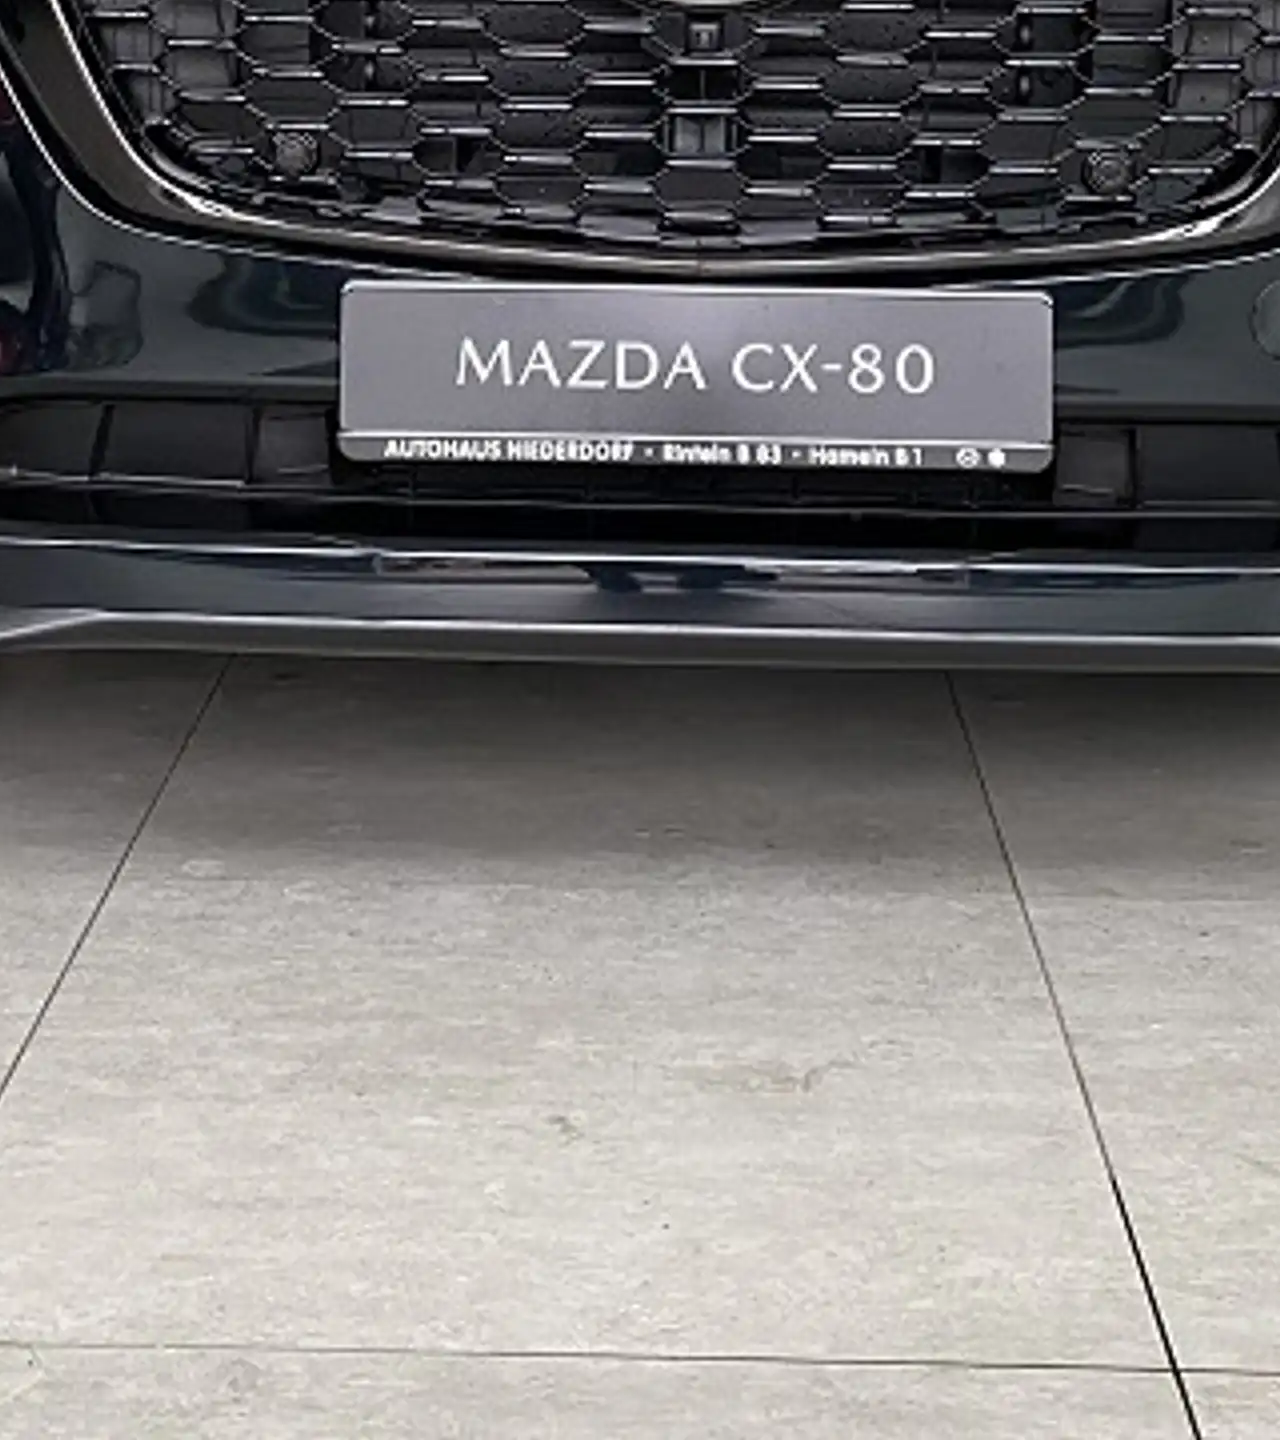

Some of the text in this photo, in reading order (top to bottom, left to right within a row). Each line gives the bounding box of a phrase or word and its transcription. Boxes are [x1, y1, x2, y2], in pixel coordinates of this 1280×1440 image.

[455, 337, 935, 394] MAZDA CX-80
[384, 439, 502, 460] AUTOHAUS
